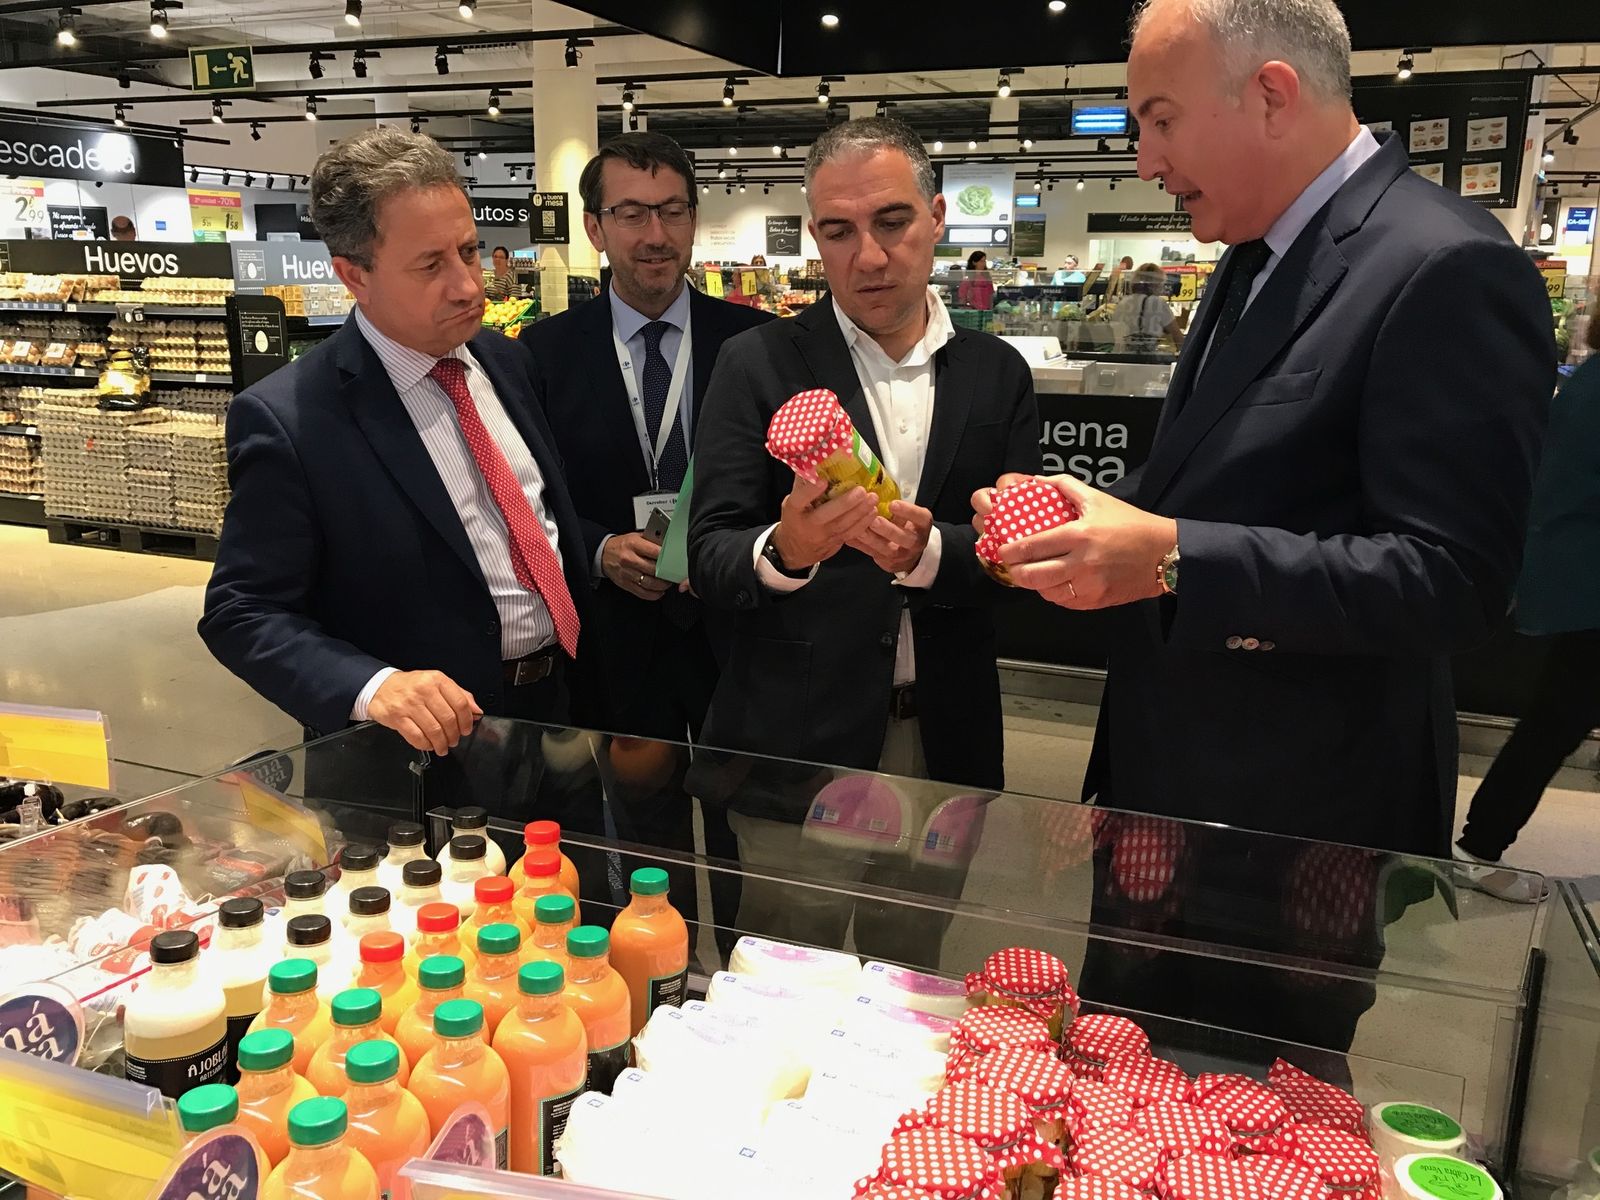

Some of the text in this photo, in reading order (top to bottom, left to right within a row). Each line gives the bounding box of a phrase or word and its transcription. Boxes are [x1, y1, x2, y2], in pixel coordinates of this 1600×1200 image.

[0, 139, 136, 173] escadea
[84, 245, 179, 275] Huevos
[1443, 1167, 1469, 1182] Cabra
[1469, 1174, 1482, 1187] La
